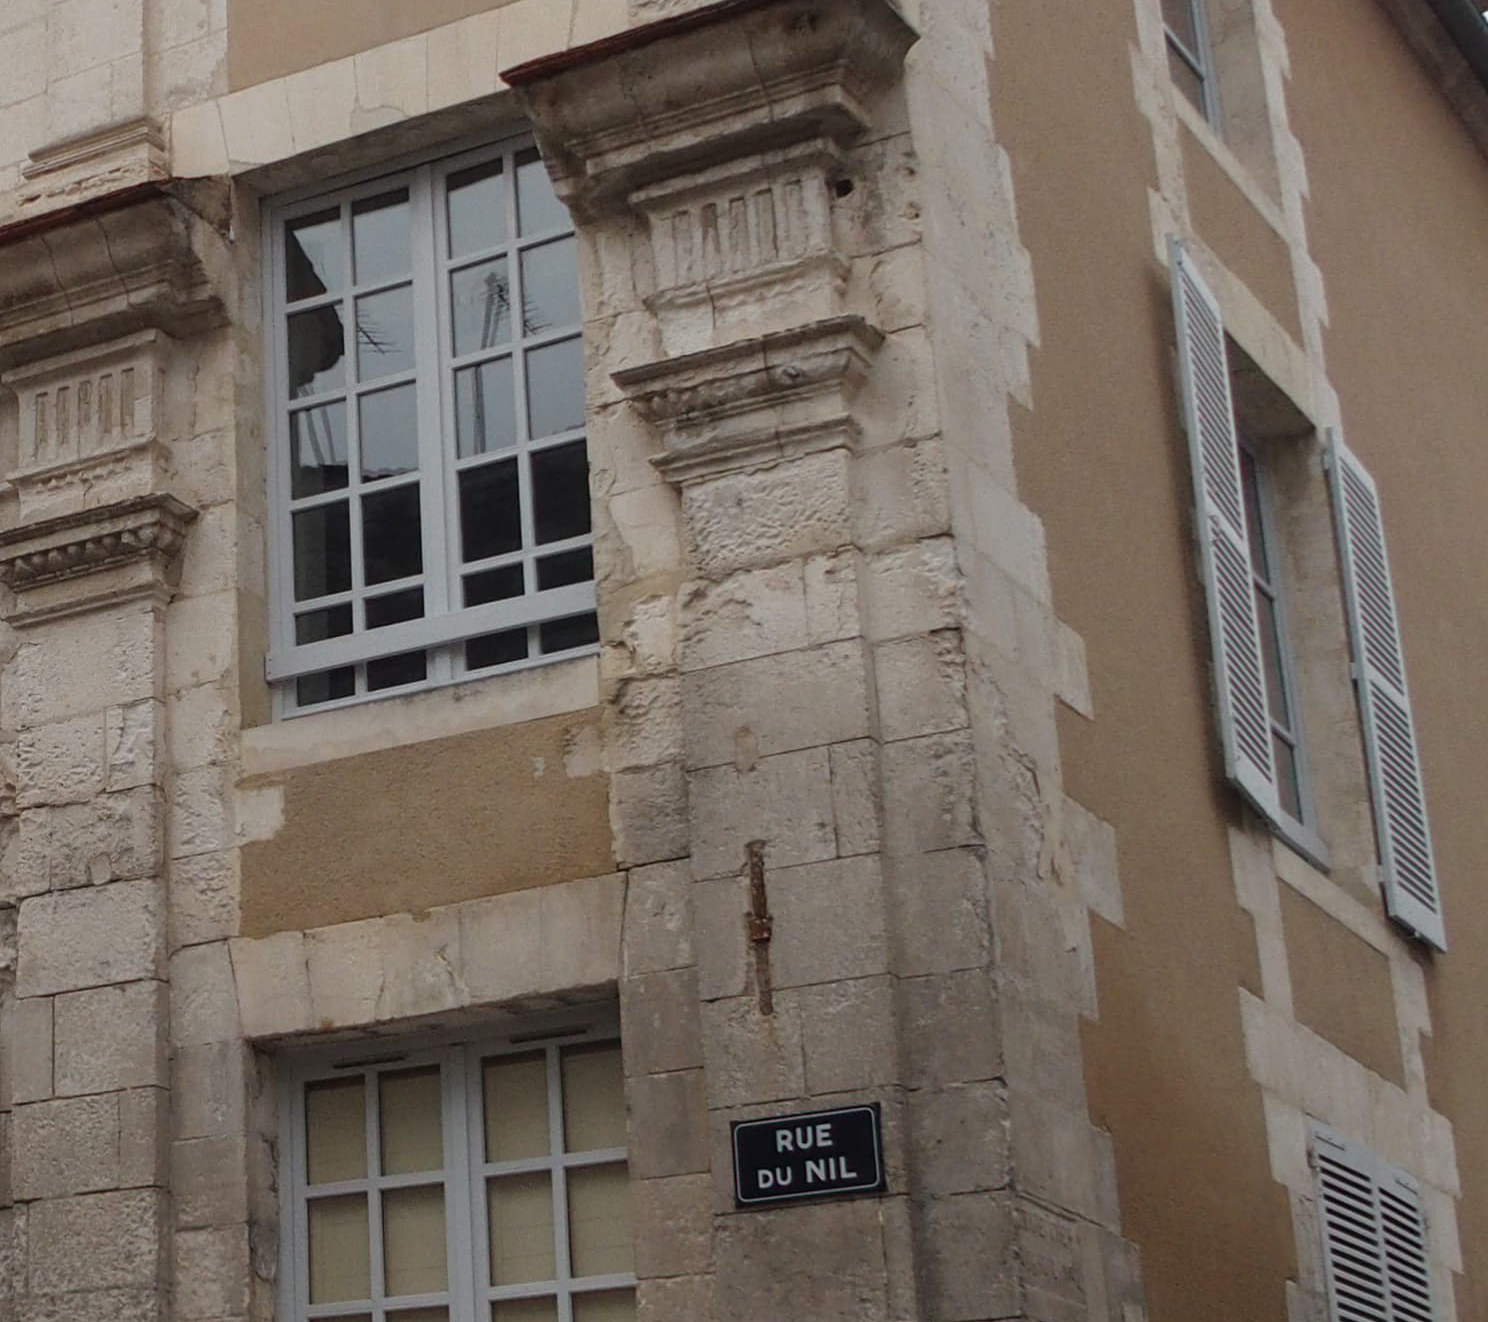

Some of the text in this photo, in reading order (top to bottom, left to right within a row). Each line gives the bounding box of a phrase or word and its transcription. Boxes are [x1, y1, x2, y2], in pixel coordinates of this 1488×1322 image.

[776, 1123, 833, 1153] RUE
[757, 1156, 858, 1189] DU NIL
